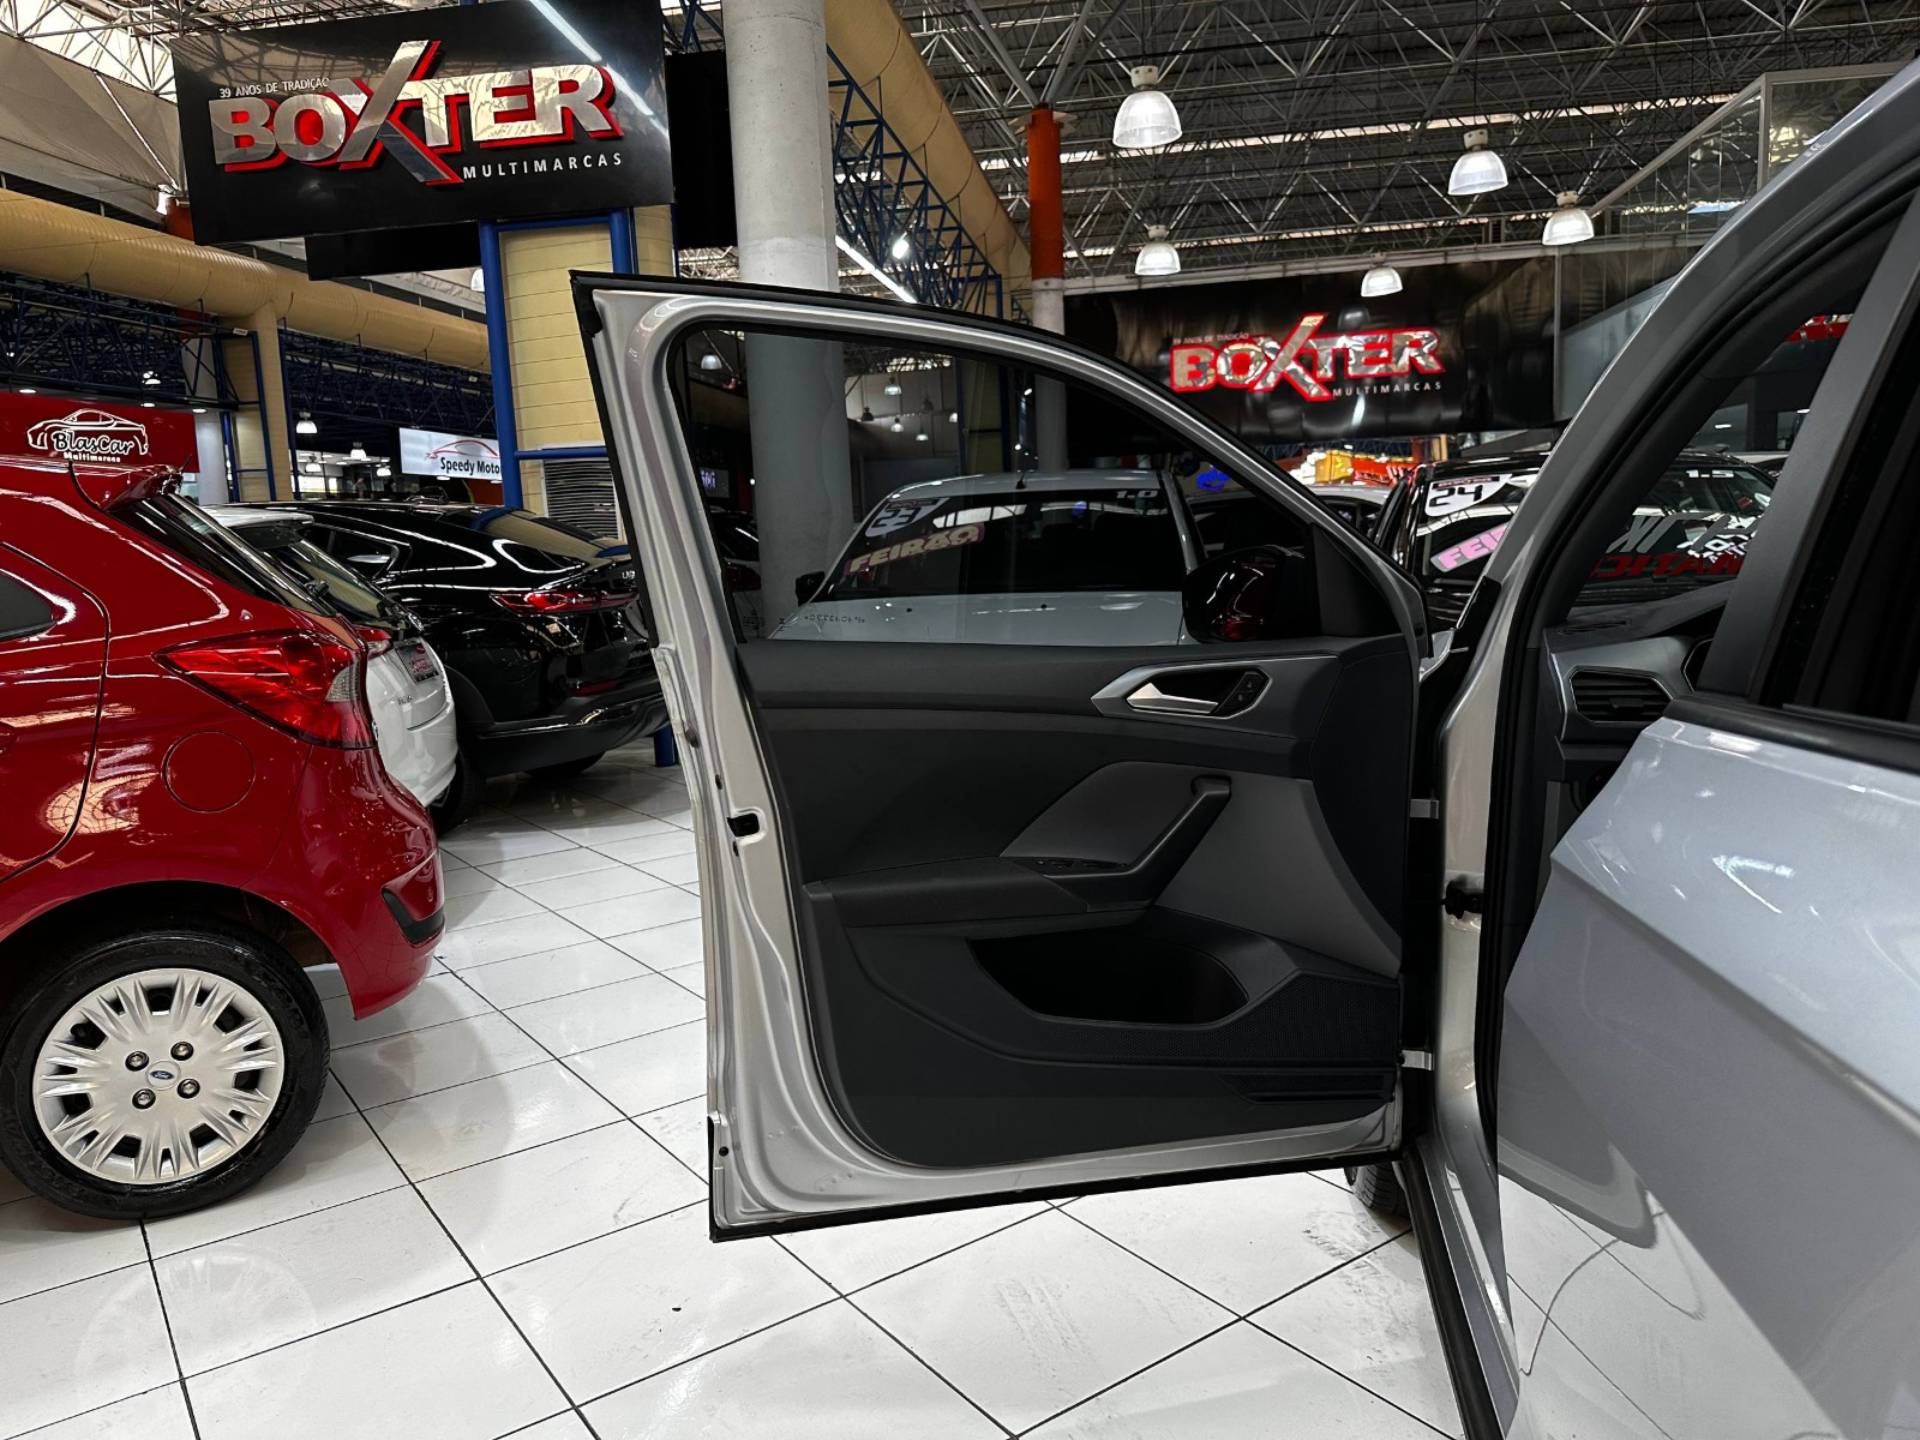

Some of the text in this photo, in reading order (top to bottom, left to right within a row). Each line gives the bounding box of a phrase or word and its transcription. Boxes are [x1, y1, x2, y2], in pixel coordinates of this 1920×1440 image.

[219, 88, 231, 98] 39
[235, 84, 262, 97] ANOS
[266, 82, 278, 94] DE
[208, 40, 624, 186] BOXTER
[463, 153, 623, 180] MULTIMARCAS
[1170, 312, 1445, 402] BOXTER
[1332, 381, 1442, 398] MULTIMARCAS
[51, 430, 135, 456] BlasCar
[440, 457, 475, 476] Speedy
[1429, 484, 1484, 508] 24
